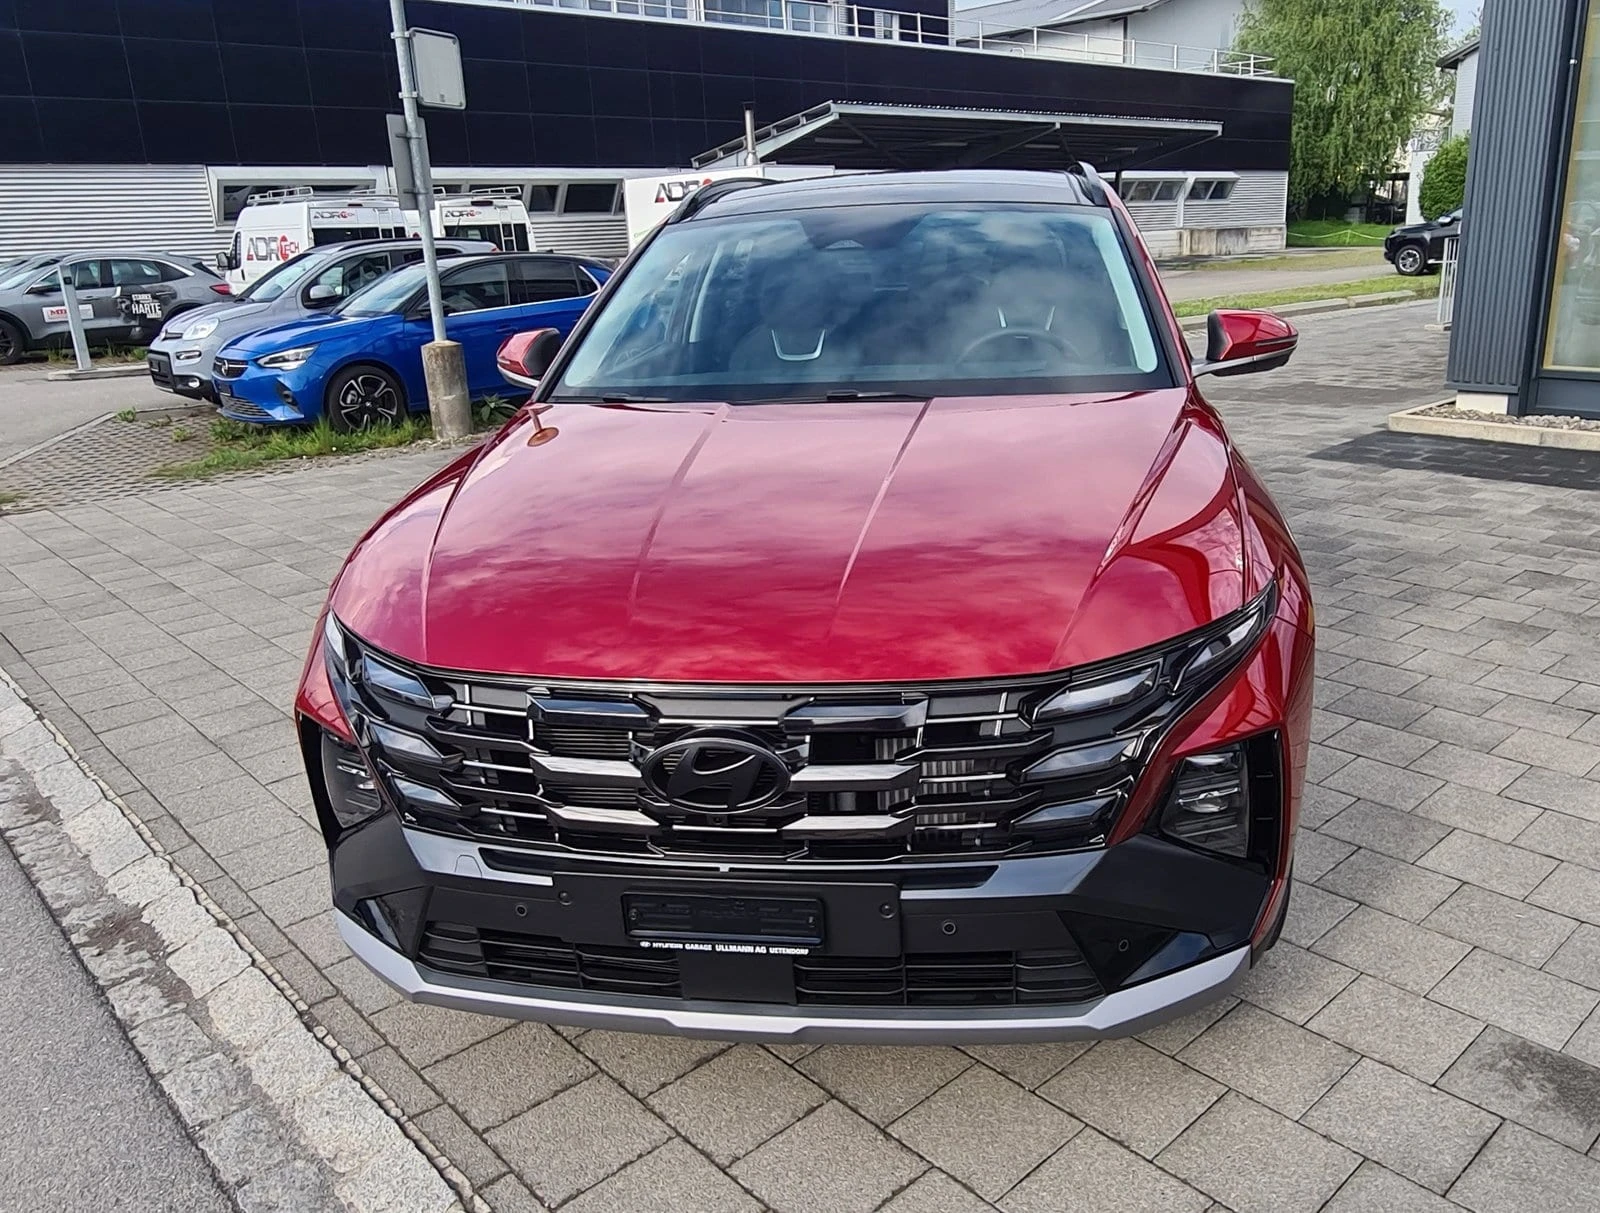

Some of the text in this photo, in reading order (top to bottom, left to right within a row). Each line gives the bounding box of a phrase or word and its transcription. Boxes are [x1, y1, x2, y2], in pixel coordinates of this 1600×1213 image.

[131, 302, 161, 314] HARTE
[684, 943, 713, 951] GARAGE
[715, 944, 754, 953] ULLMANN
